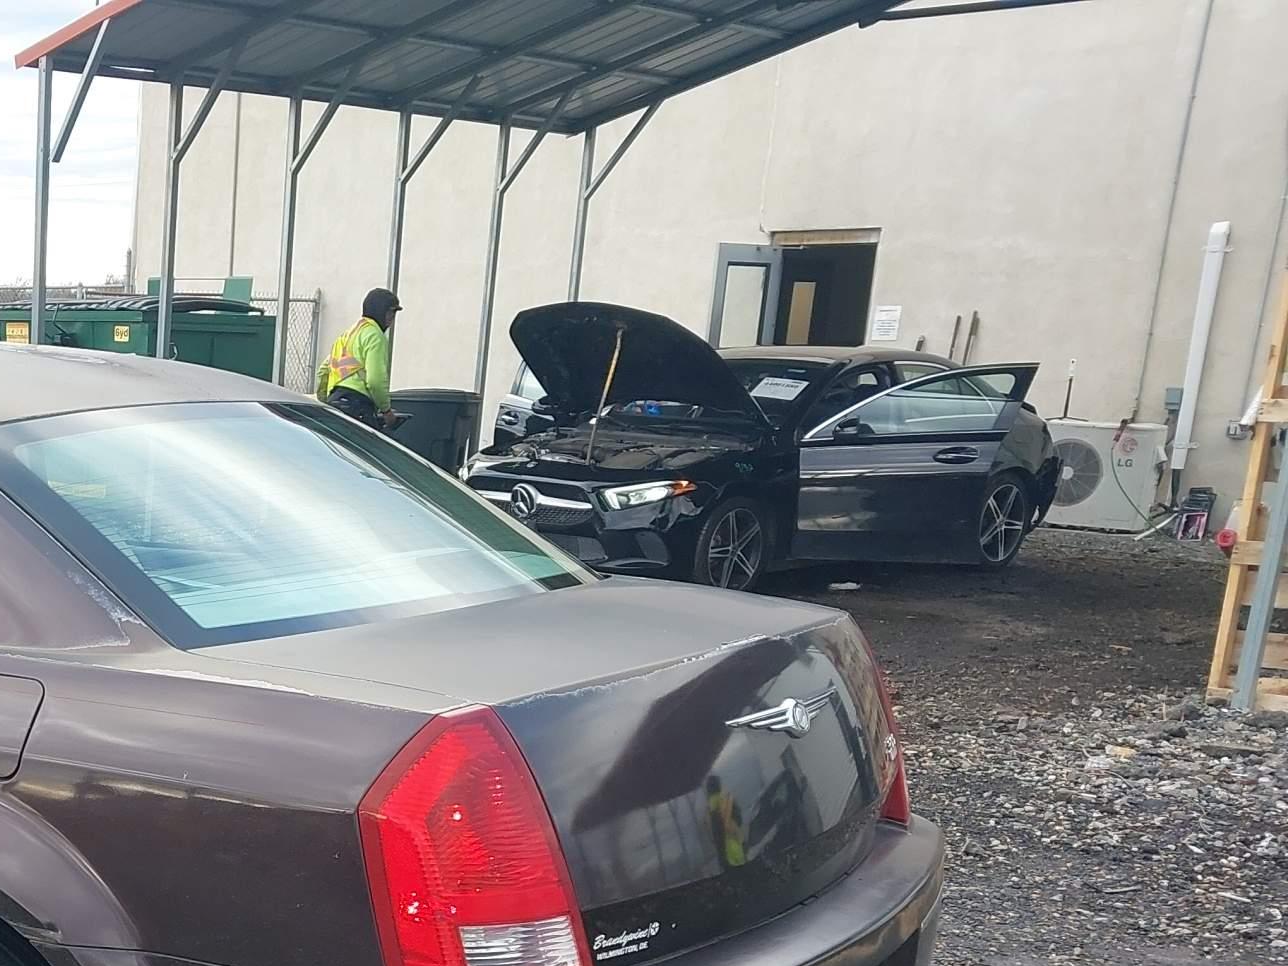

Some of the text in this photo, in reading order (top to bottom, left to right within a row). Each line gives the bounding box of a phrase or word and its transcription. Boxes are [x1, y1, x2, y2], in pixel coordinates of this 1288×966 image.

[115, 327, 129, 339] 6yd
[1117, 458, 1133, 467] LG
[593, 928, 649, 950] Brandywine
